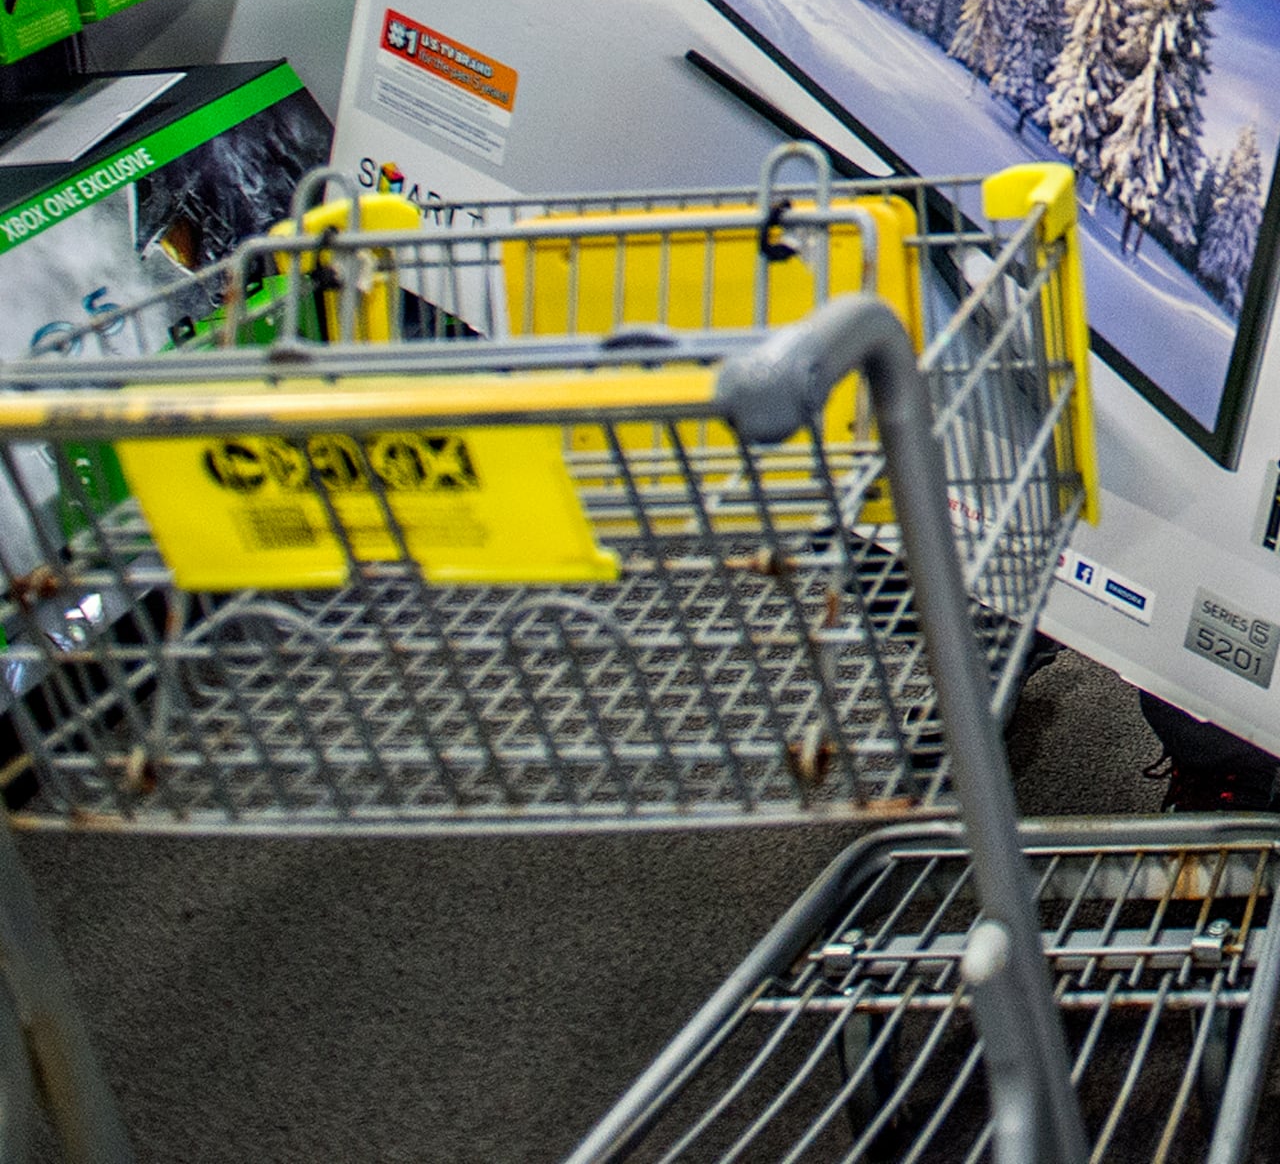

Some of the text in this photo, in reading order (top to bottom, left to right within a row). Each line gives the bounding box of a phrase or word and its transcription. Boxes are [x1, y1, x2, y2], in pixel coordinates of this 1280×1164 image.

[387, 19, 418, 55] #1
[455, 49, 494, 78] BRAND
[0, 147, 155, 242] XBOX ONE EXCLUSIVE
[1202, 598, 1272, 647] SERIES 5
[1197, 629, 1263, 677] 5201
